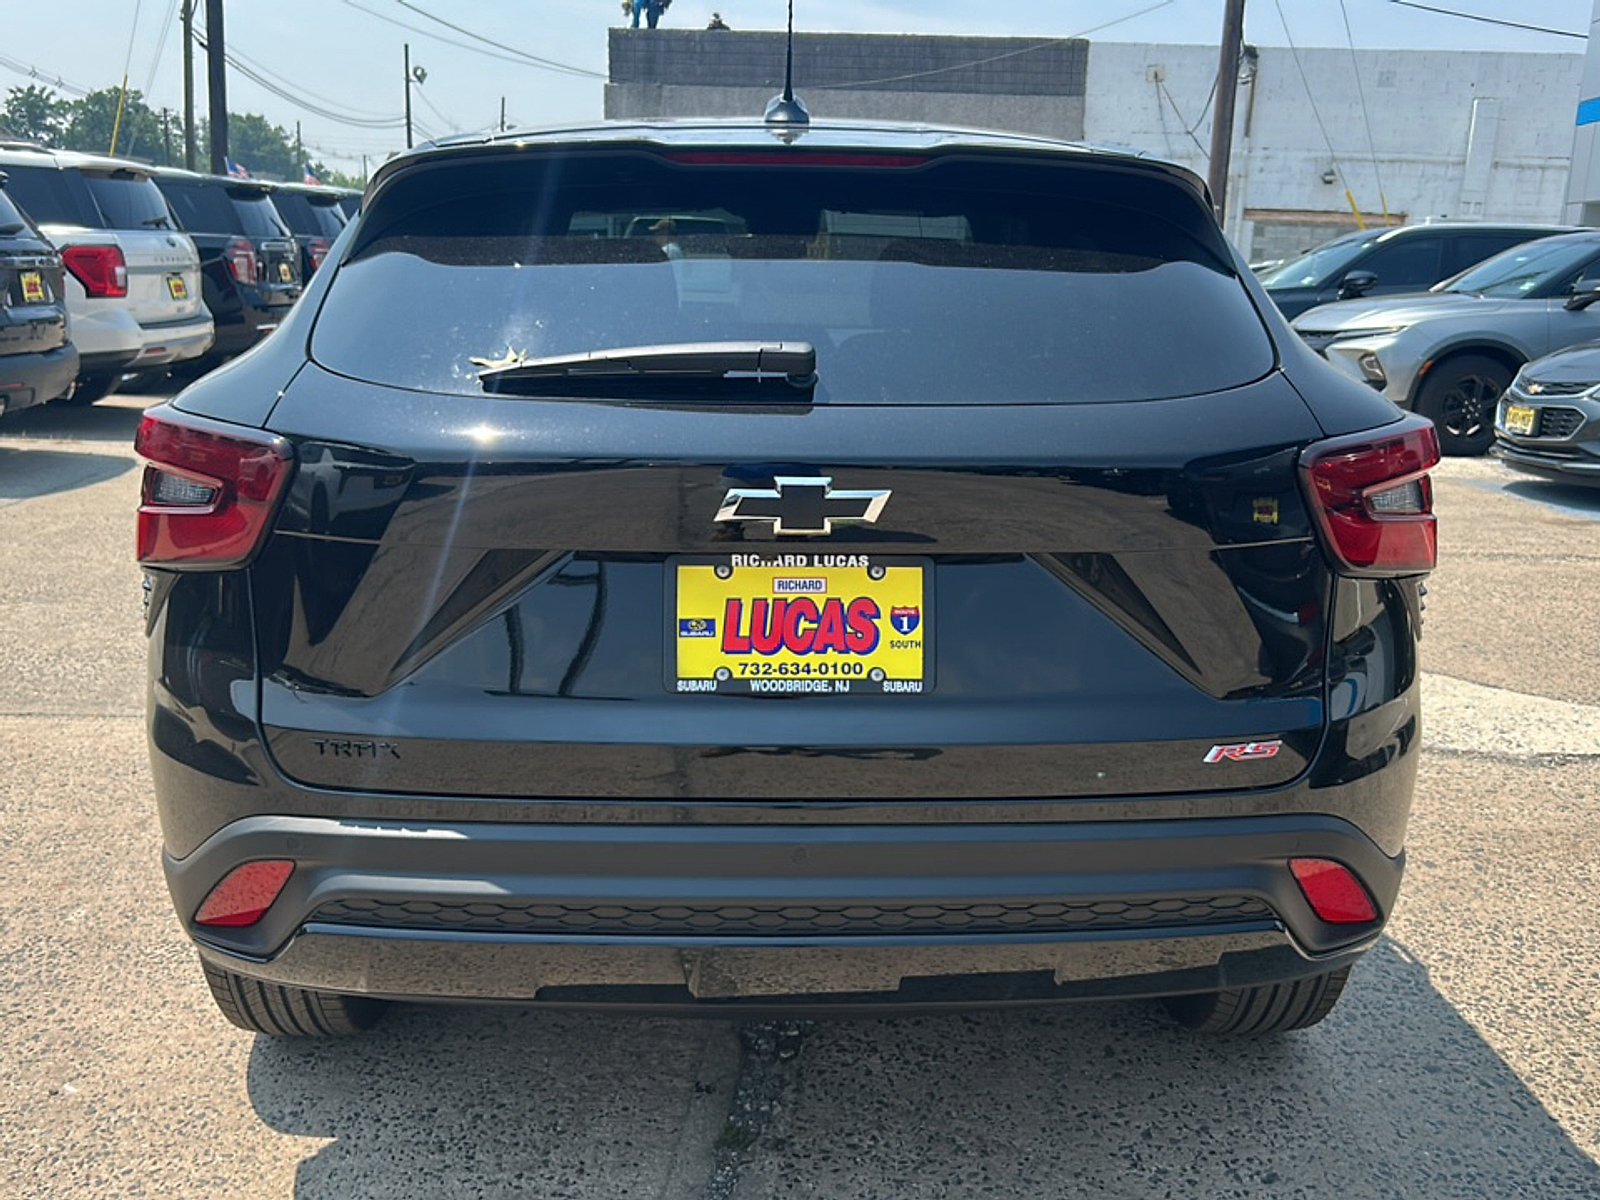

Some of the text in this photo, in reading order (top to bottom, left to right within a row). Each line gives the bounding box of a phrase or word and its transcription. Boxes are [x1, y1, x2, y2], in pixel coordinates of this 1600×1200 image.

[813, 555, 870, 567] LUCAS
[777, 580, 823, 591] RICHARD
[721, 596, 881, 657] LUCAS
[899, 616, 911, 632] 1
[890, 640, 921, 649] SOUTH
[738, 662, 864, 676] 732-634-0100
[677, 680, 717, 692] SUBARU
[835, 680, 850, 692] NJ
[882, 680, 923, 693] SUBARU
[1202, 739, 1283, 763] RS
